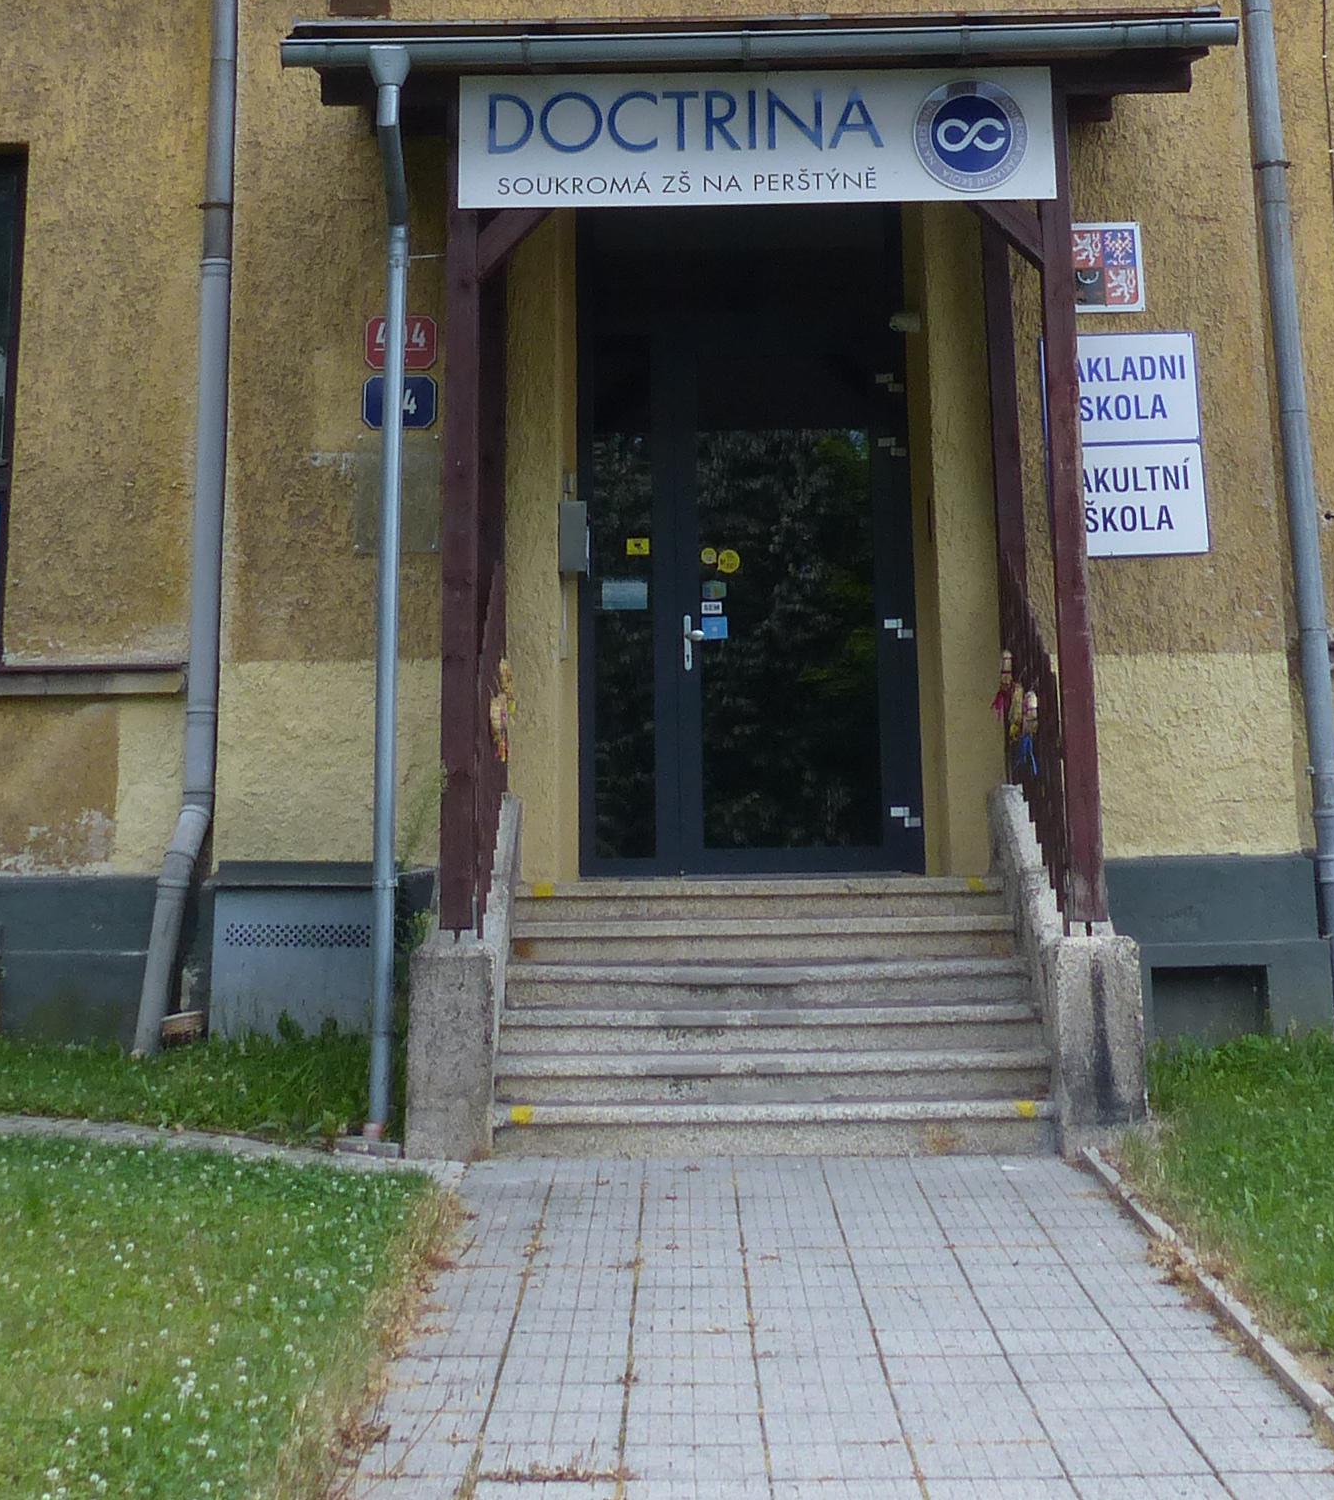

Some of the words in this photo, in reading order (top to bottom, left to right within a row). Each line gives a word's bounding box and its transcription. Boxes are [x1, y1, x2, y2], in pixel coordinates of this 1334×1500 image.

[488, 87, 884, 155] DOCTRINA
[497, 172, 650, 195] SOUKROMÁ
[662, 170, 691, 194] ZŠ
[703, 175, 742, 192] NA
[753, 166, 877, 191] PERŠTÝNĚ
[375, 322, 426, 348] 44
[1082, 457, 1190, 493] AKULTNÍ
[1085, 500, 1174, 533] ŠKOLA
